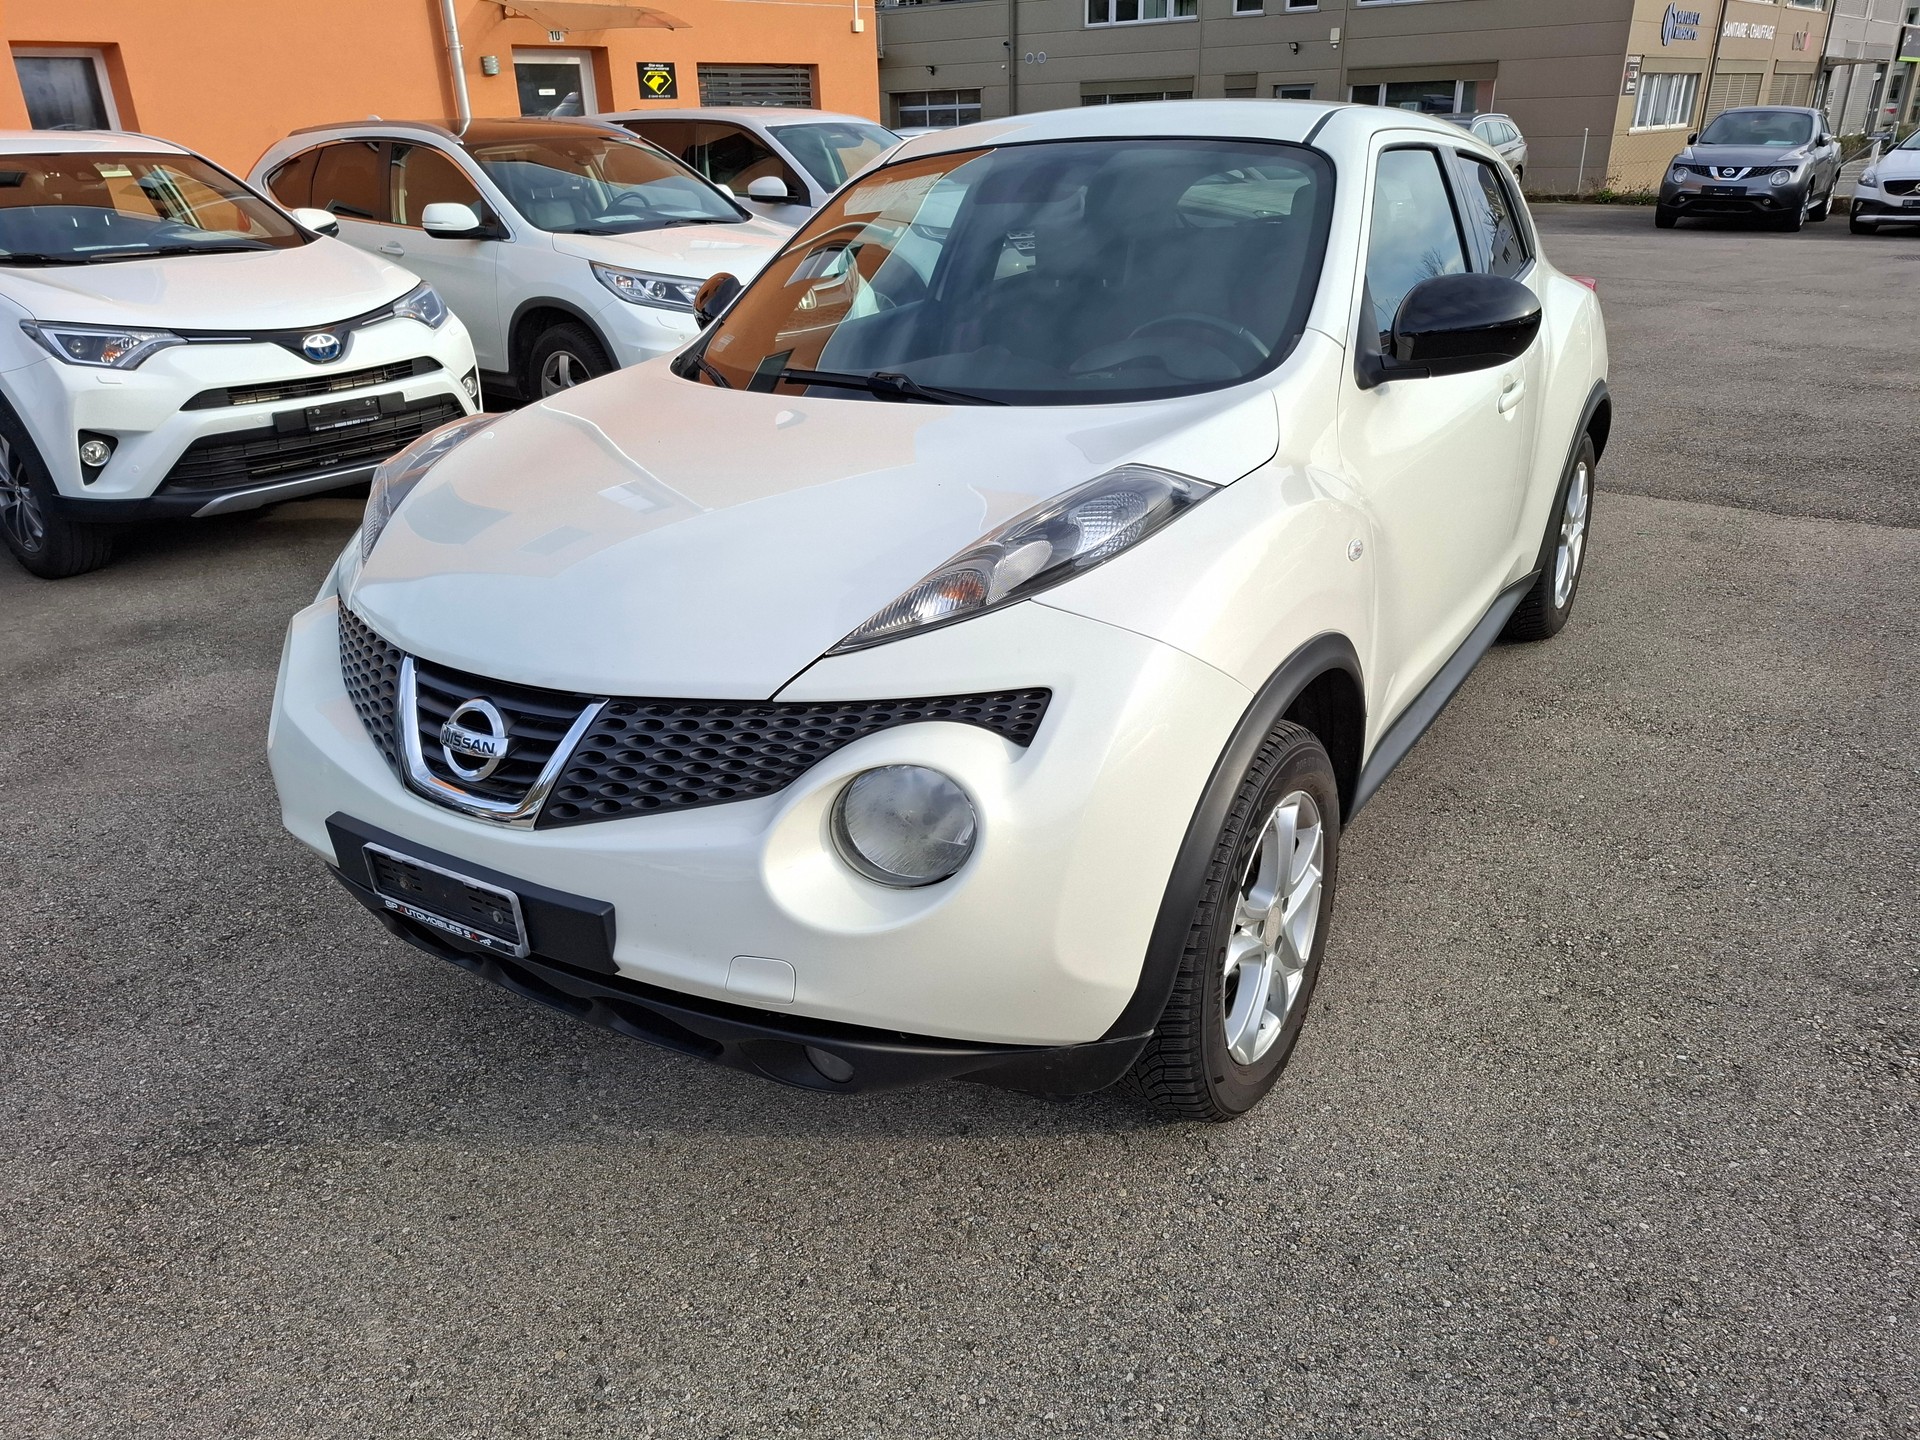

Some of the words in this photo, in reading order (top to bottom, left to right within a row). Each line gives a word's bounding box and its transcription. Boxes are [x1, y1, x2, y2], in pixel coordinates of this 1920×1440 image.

[1722, 21, 1748, 37] SANITAIRE
[1750, 23, 1776, 40] CHAUFFAGE
[443, 728, 495, 754] NISSAN
[398, 904, 462, 935] AUTOMOBILES
[463, 929, 479, 942] SA
